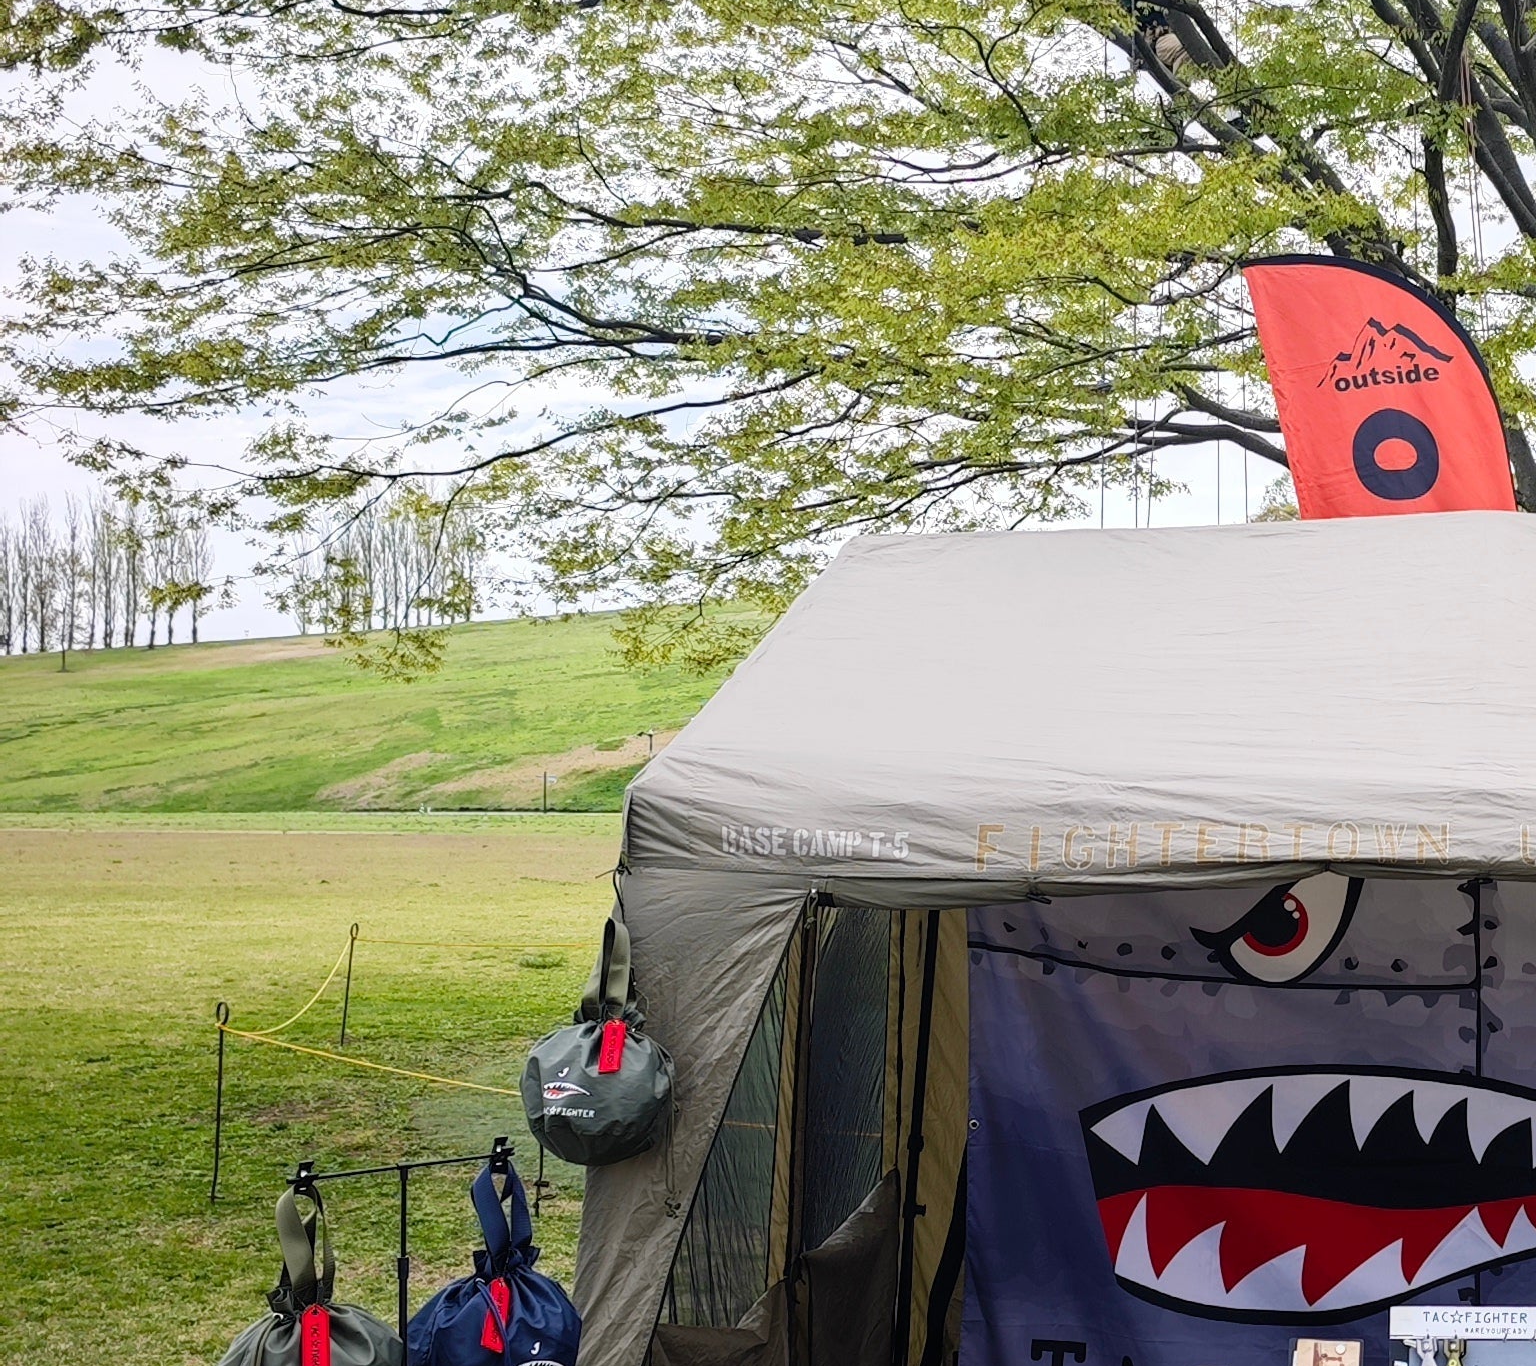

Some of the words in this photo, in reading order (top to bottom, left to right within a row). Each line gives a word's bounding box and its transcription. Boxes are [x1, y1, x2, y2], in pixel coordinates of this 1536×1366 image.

[1335, 364, 1439, 392] outside
[721, 825, 787, 856] BASE
[793, 828, 862, 858] CAMP
[869, 831, 911, 859] T-5
[974, 821, 1450, 873] FIGHTERTOWN
[1423, 1311, 1449, 1324] TAC
[1465, 1311, 1528, 1324] FIGHTER
